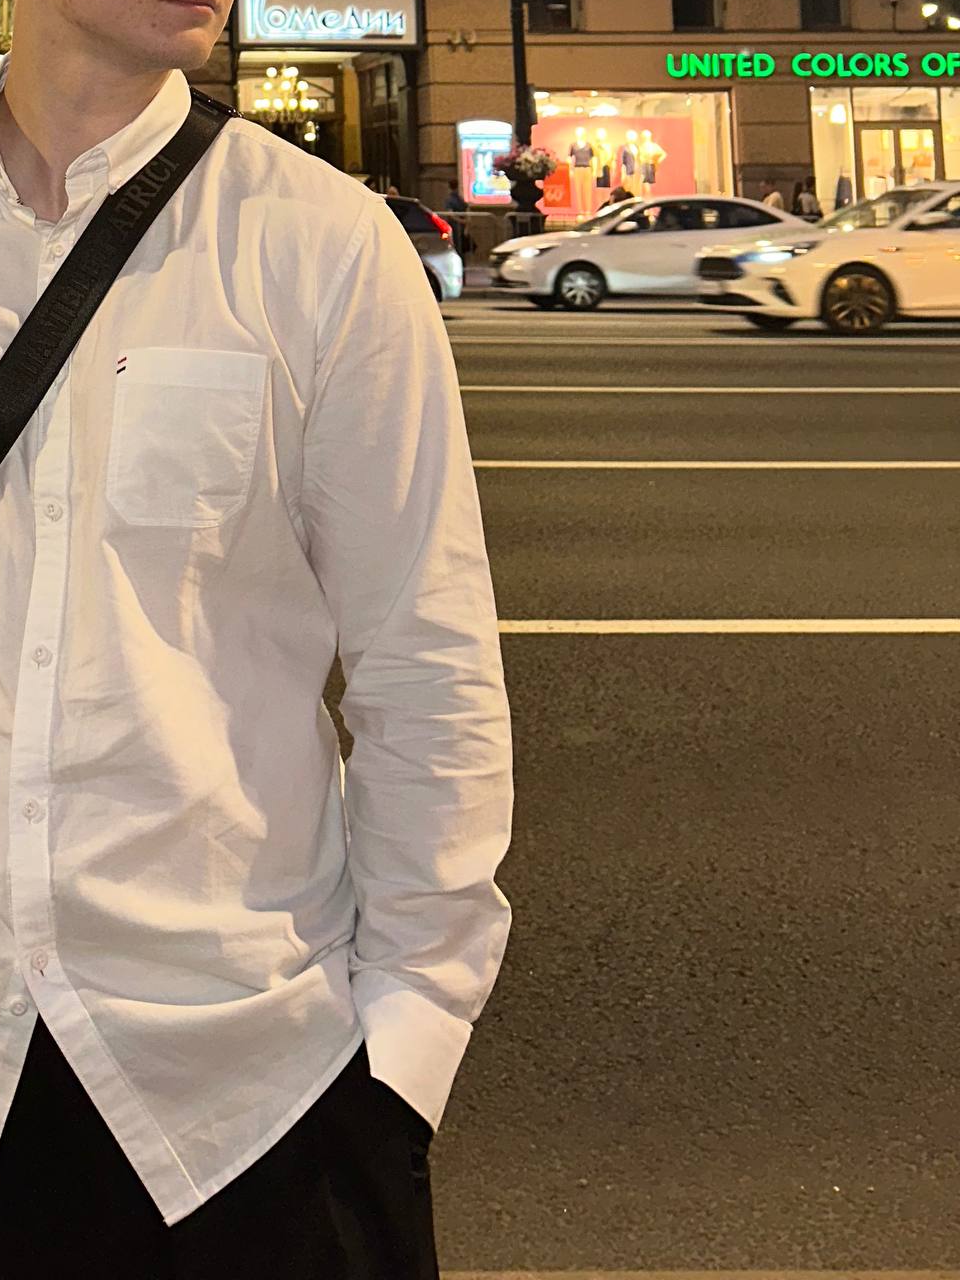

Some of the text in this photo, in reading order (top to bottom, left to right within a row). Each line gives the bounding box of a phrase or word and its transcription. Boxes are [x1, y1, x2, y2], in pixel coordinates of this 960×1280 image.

[666, 52, 960, 78] UNITED COLORS OF
